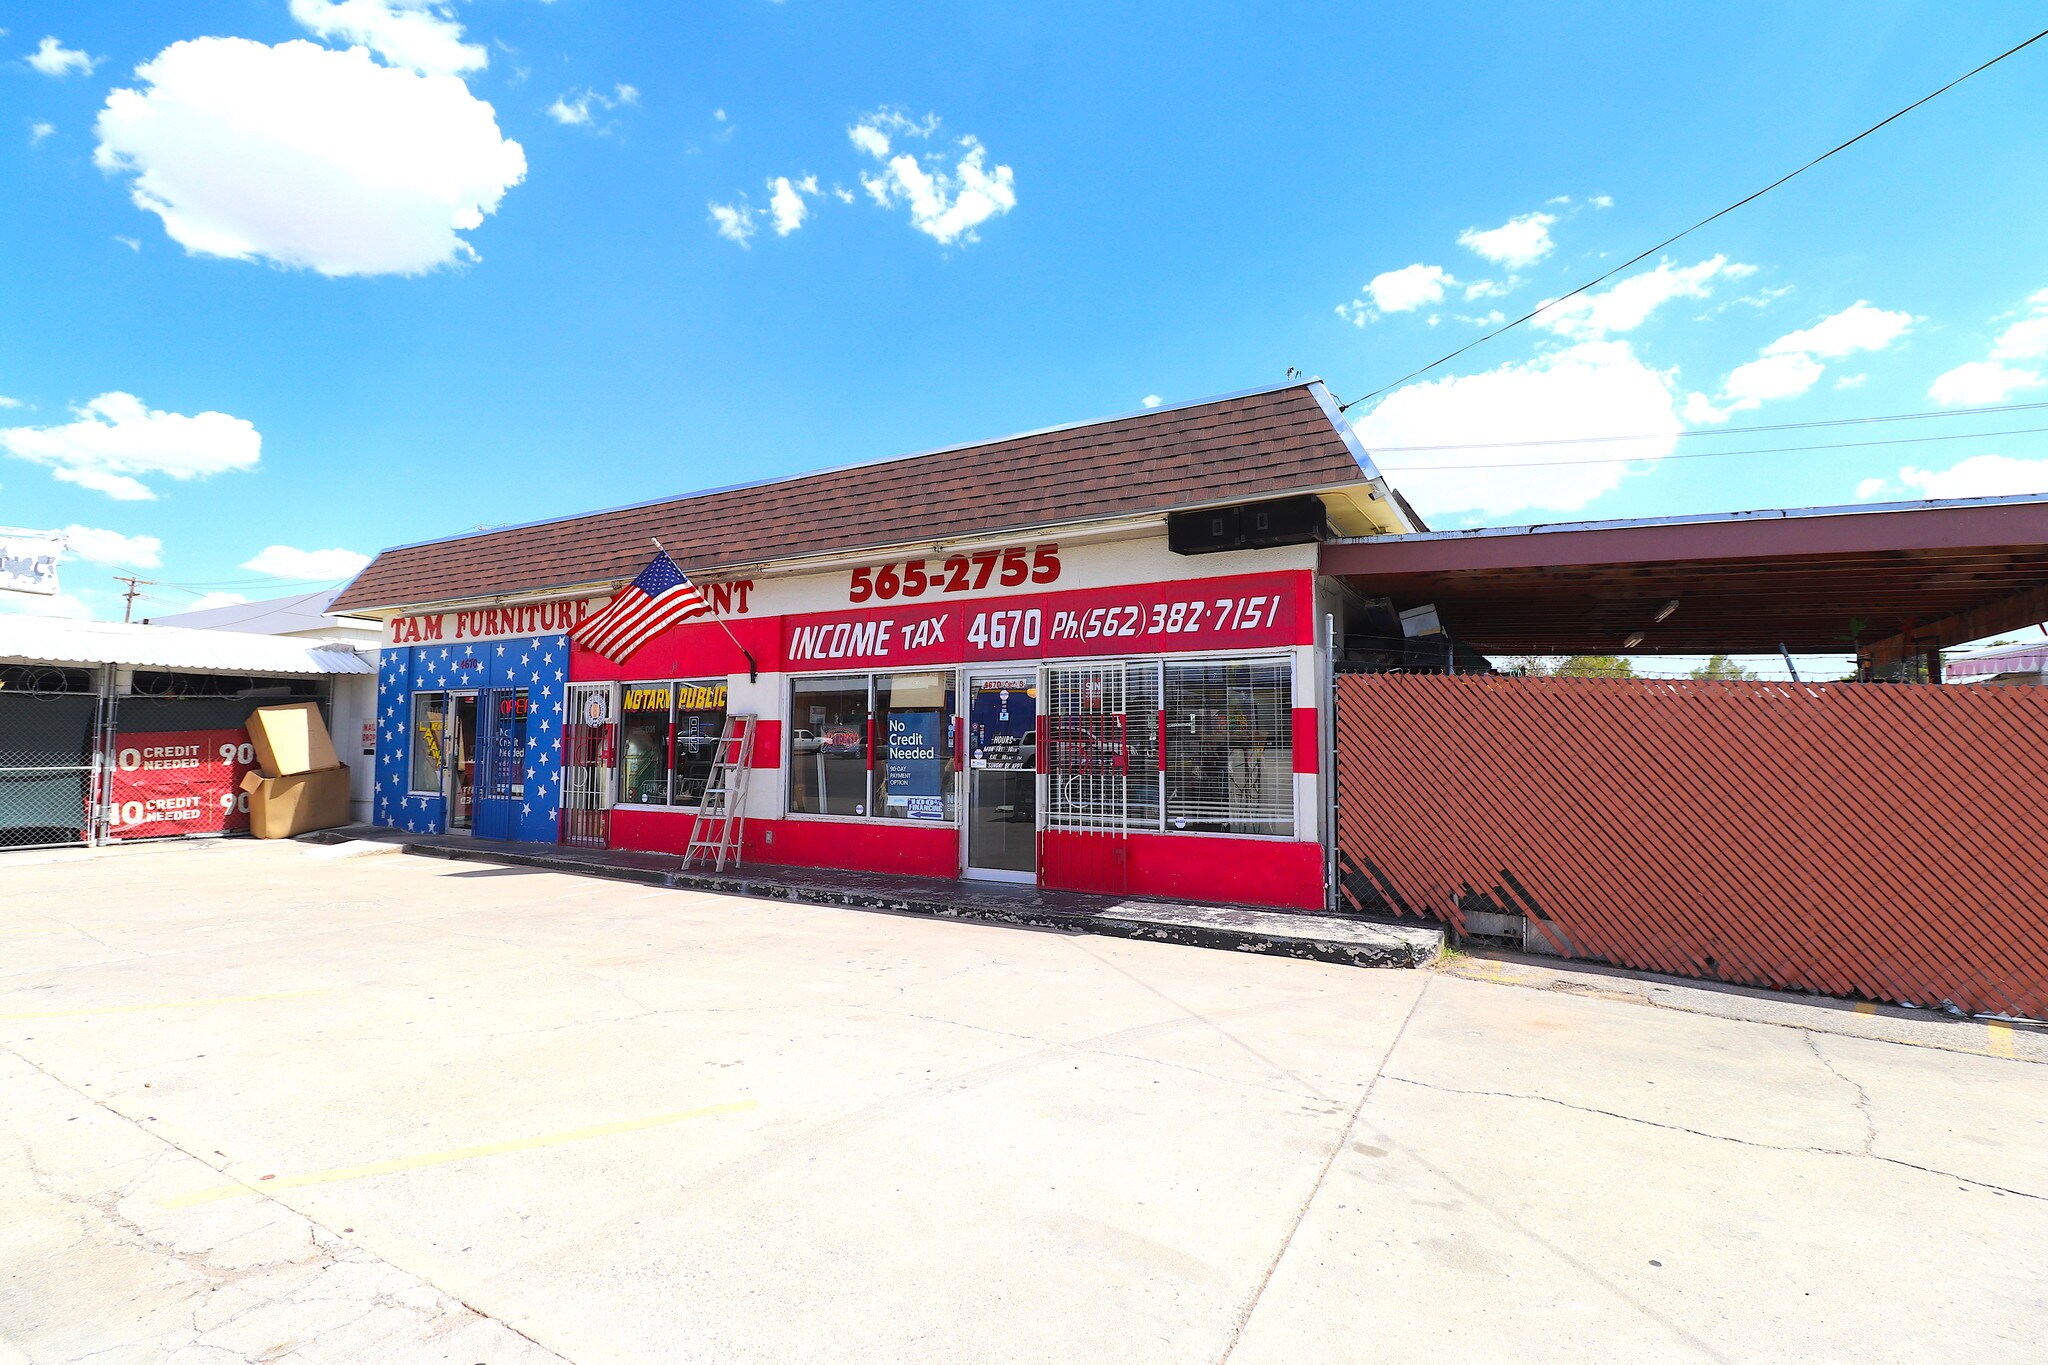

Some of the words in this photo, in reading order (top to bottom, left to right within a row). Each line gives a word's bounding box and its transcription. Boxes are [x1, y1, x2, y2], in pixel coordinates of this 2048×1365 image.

[850, 543, 1061, 603] 565-2755
[391, 614, 443, 643] TAM
[455, 599, 591, 639] FURNITURE
[788, 620, 895, 660] INCOME
[901, 613, 949, 650] TAX
[967, 608, 1042, 649] 4670
[460, 658, 478, 669] 4670
[623, 689, 671, 710] NOTARY
[678, 686, 728, 710] PUBLIC
[500, 698, 528, 714] OPE
[889, 720, 906, 732] No
[690, 718, 698, 751] OPEN
[889, 733, 923, 746] Credit
[143, 745, 200, 758] CREDIT
[418, 722, 446, 768] LAYAWA
[219, 743, 254, 766] 90
[889, 747, 935, 759] Needed
[143, 758, 200, 771] NEEDED
[145, 796, 202, 810] CREDIT
[219, 792, 250, 816] 90
[909, 804, 943, 812] FINANCING
[145, 809, 201, 822] NEEDED
